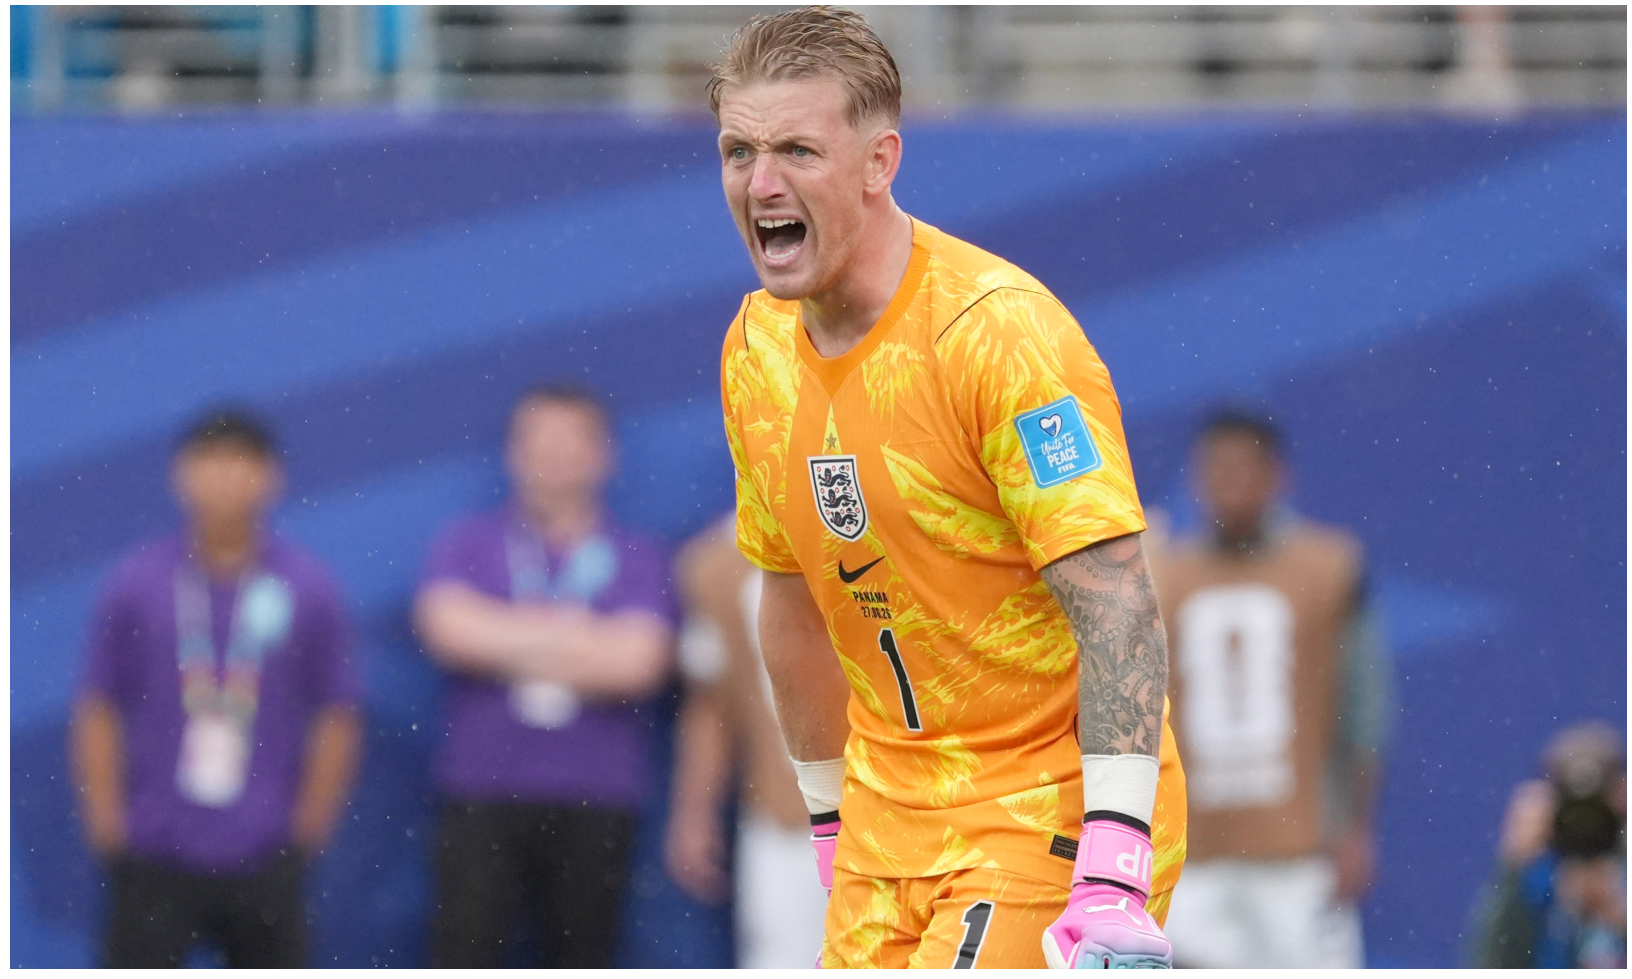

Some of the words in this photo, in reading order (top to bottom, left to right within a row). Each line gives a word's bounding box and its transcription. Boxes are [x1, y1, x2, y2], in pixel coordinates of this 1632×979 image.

[1041, 438, 1063, 455] Unite
[1061, 432, 1075, 448] For
[1047, 445, 1079, 468] PEACE
[1058, 463, 1076, 474] FIFA
[853, 591, 889, 604] PANAMA
[861, 606, 892, 620] 27.06.26
[877, 627, 924, 732] 1
[951, 899, 996, 969] 1
